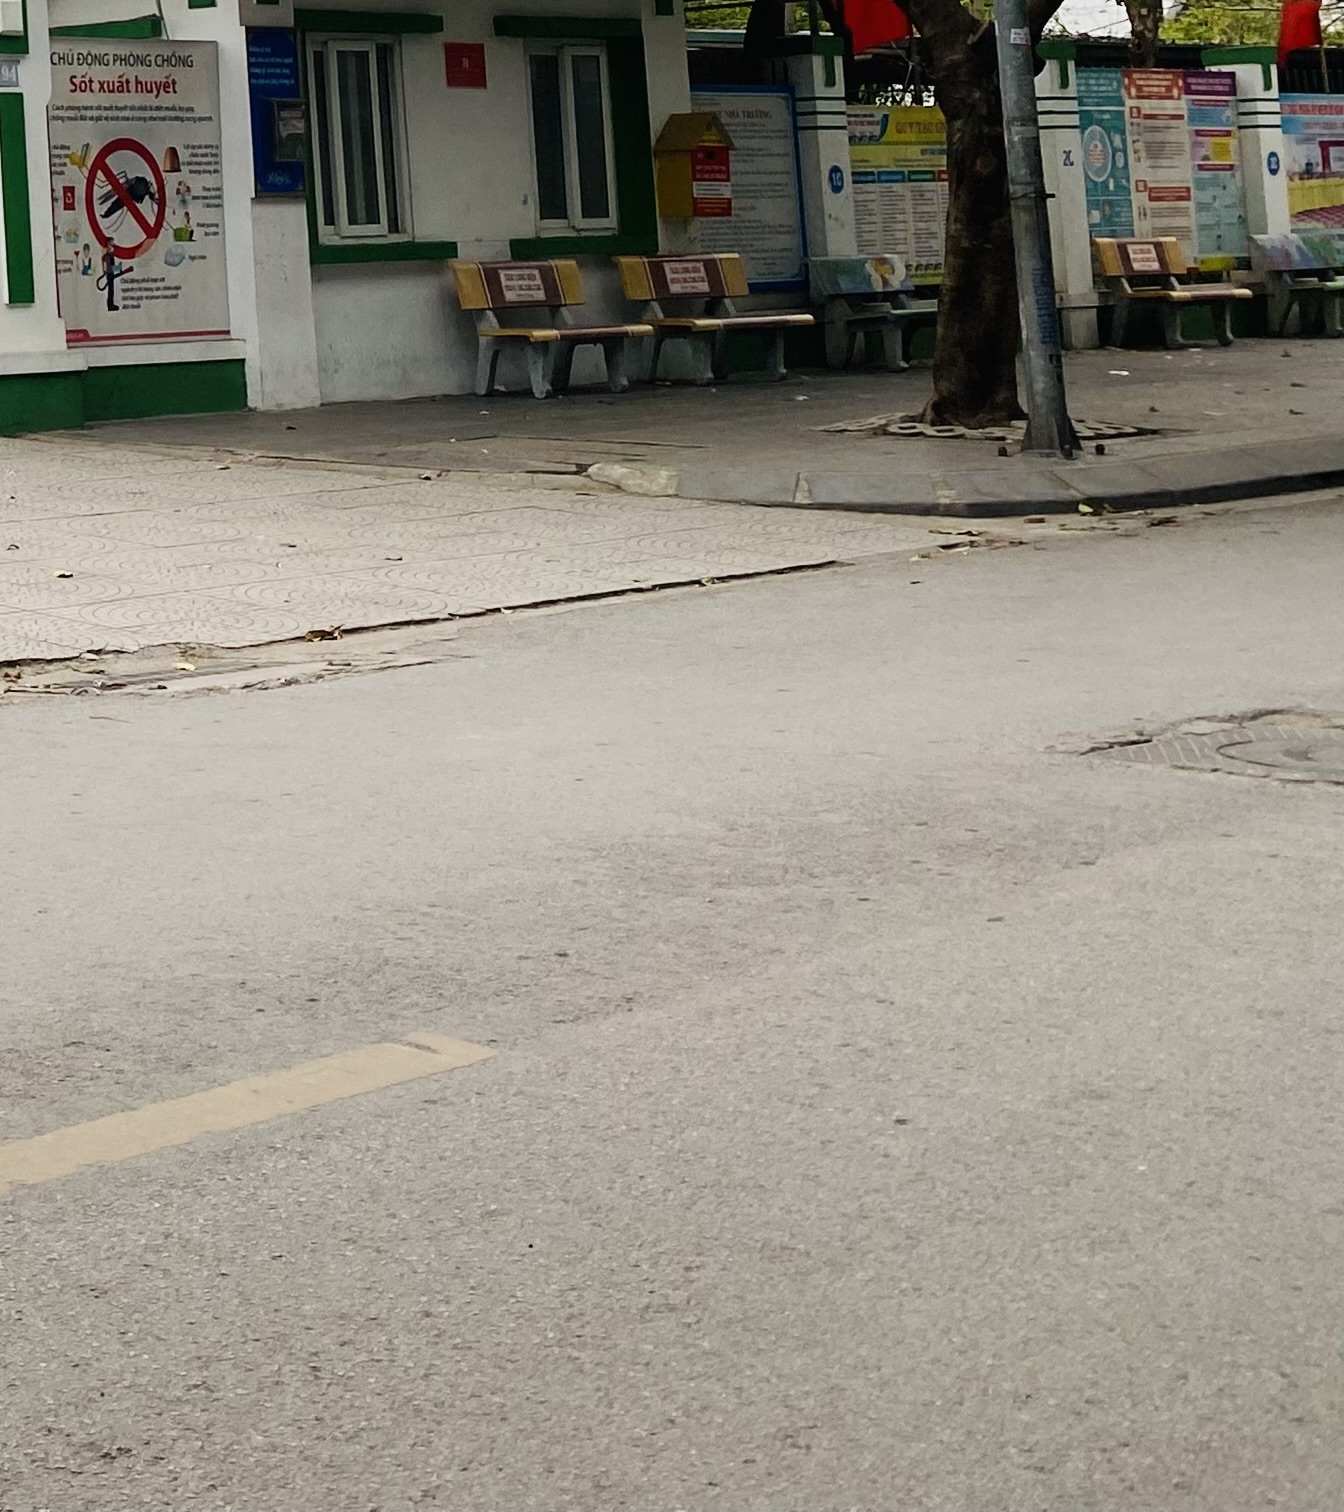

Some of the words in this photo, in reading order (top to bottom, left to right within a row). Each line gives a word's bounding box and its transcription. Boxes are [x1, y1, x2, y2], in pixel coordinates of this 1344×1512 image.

[50, 48, 74, 66] CHỦ
[112, 50, 152, 67] PHÒNG
[154, 50, 194, 68] CHỐNG
[69, 72, 94, 94] Sốt
[98, 72, 131, 94] xuất
[134, 73, 178, 99] huyết
